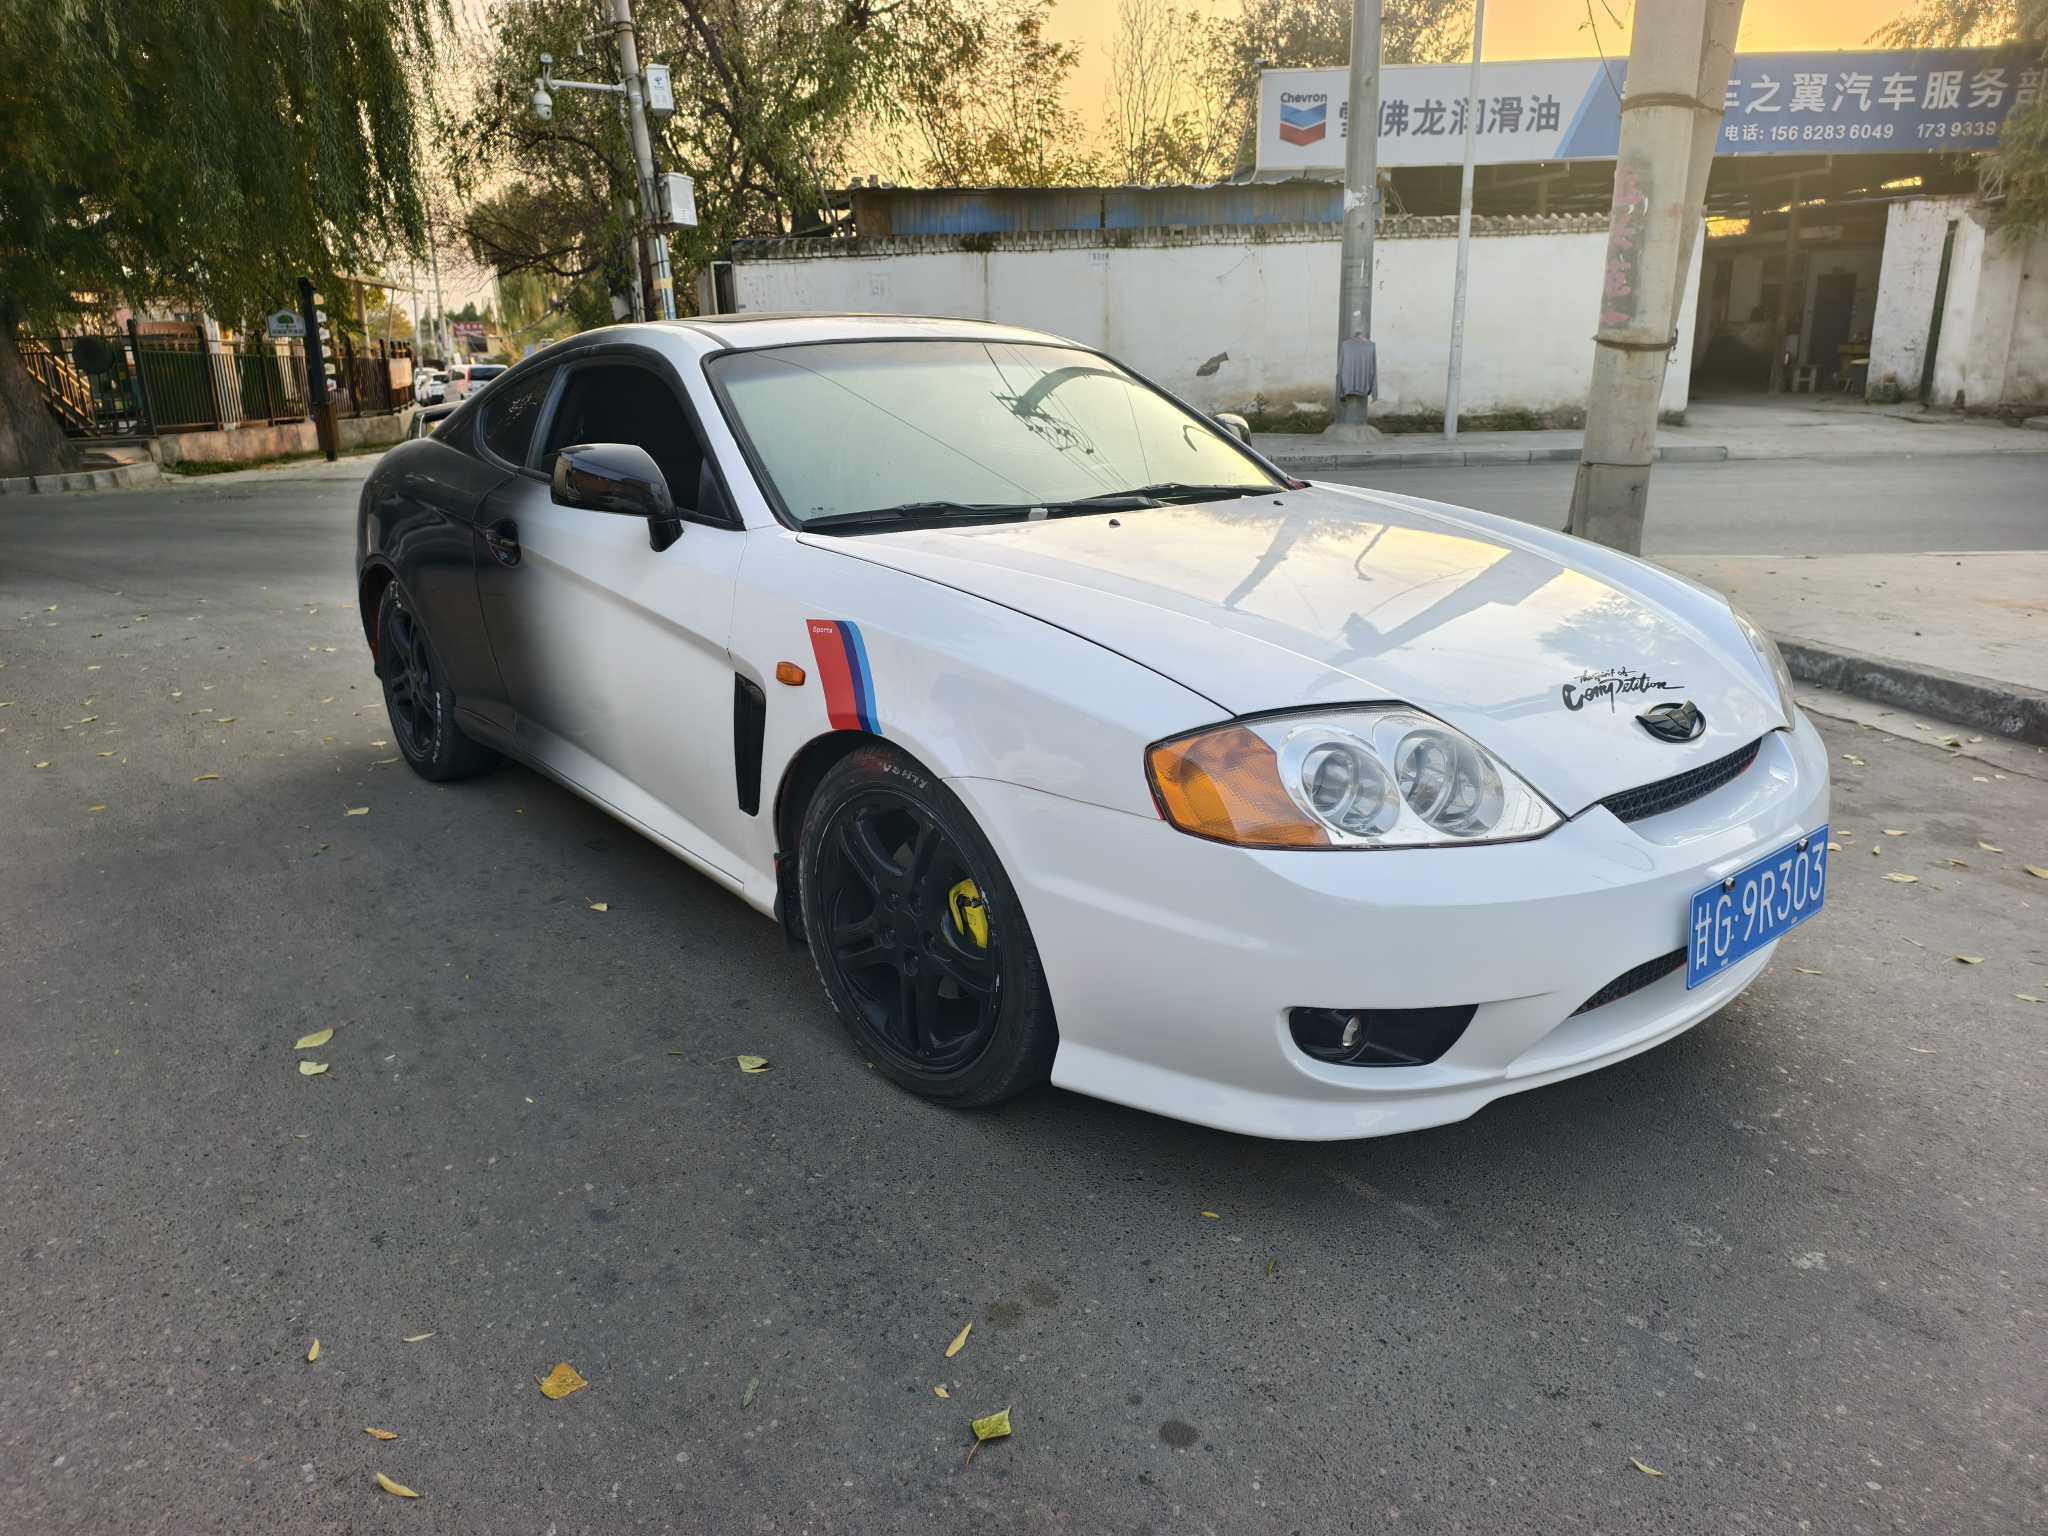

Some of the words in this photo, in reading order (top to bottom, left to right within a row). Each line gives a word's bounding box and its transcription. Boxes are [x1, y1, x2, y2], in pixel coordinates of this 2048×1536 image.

[1280, 92, 1328, 103] Chevron
[1339, 94, 1561, 138] 佛龙润滑油
[1770, 125, 1799, 141] 156
[1802, 124, 1847, 140] 8283
[1850, 123, 1894, 140] 6049
[1916, 122, 1946, 139] 173
